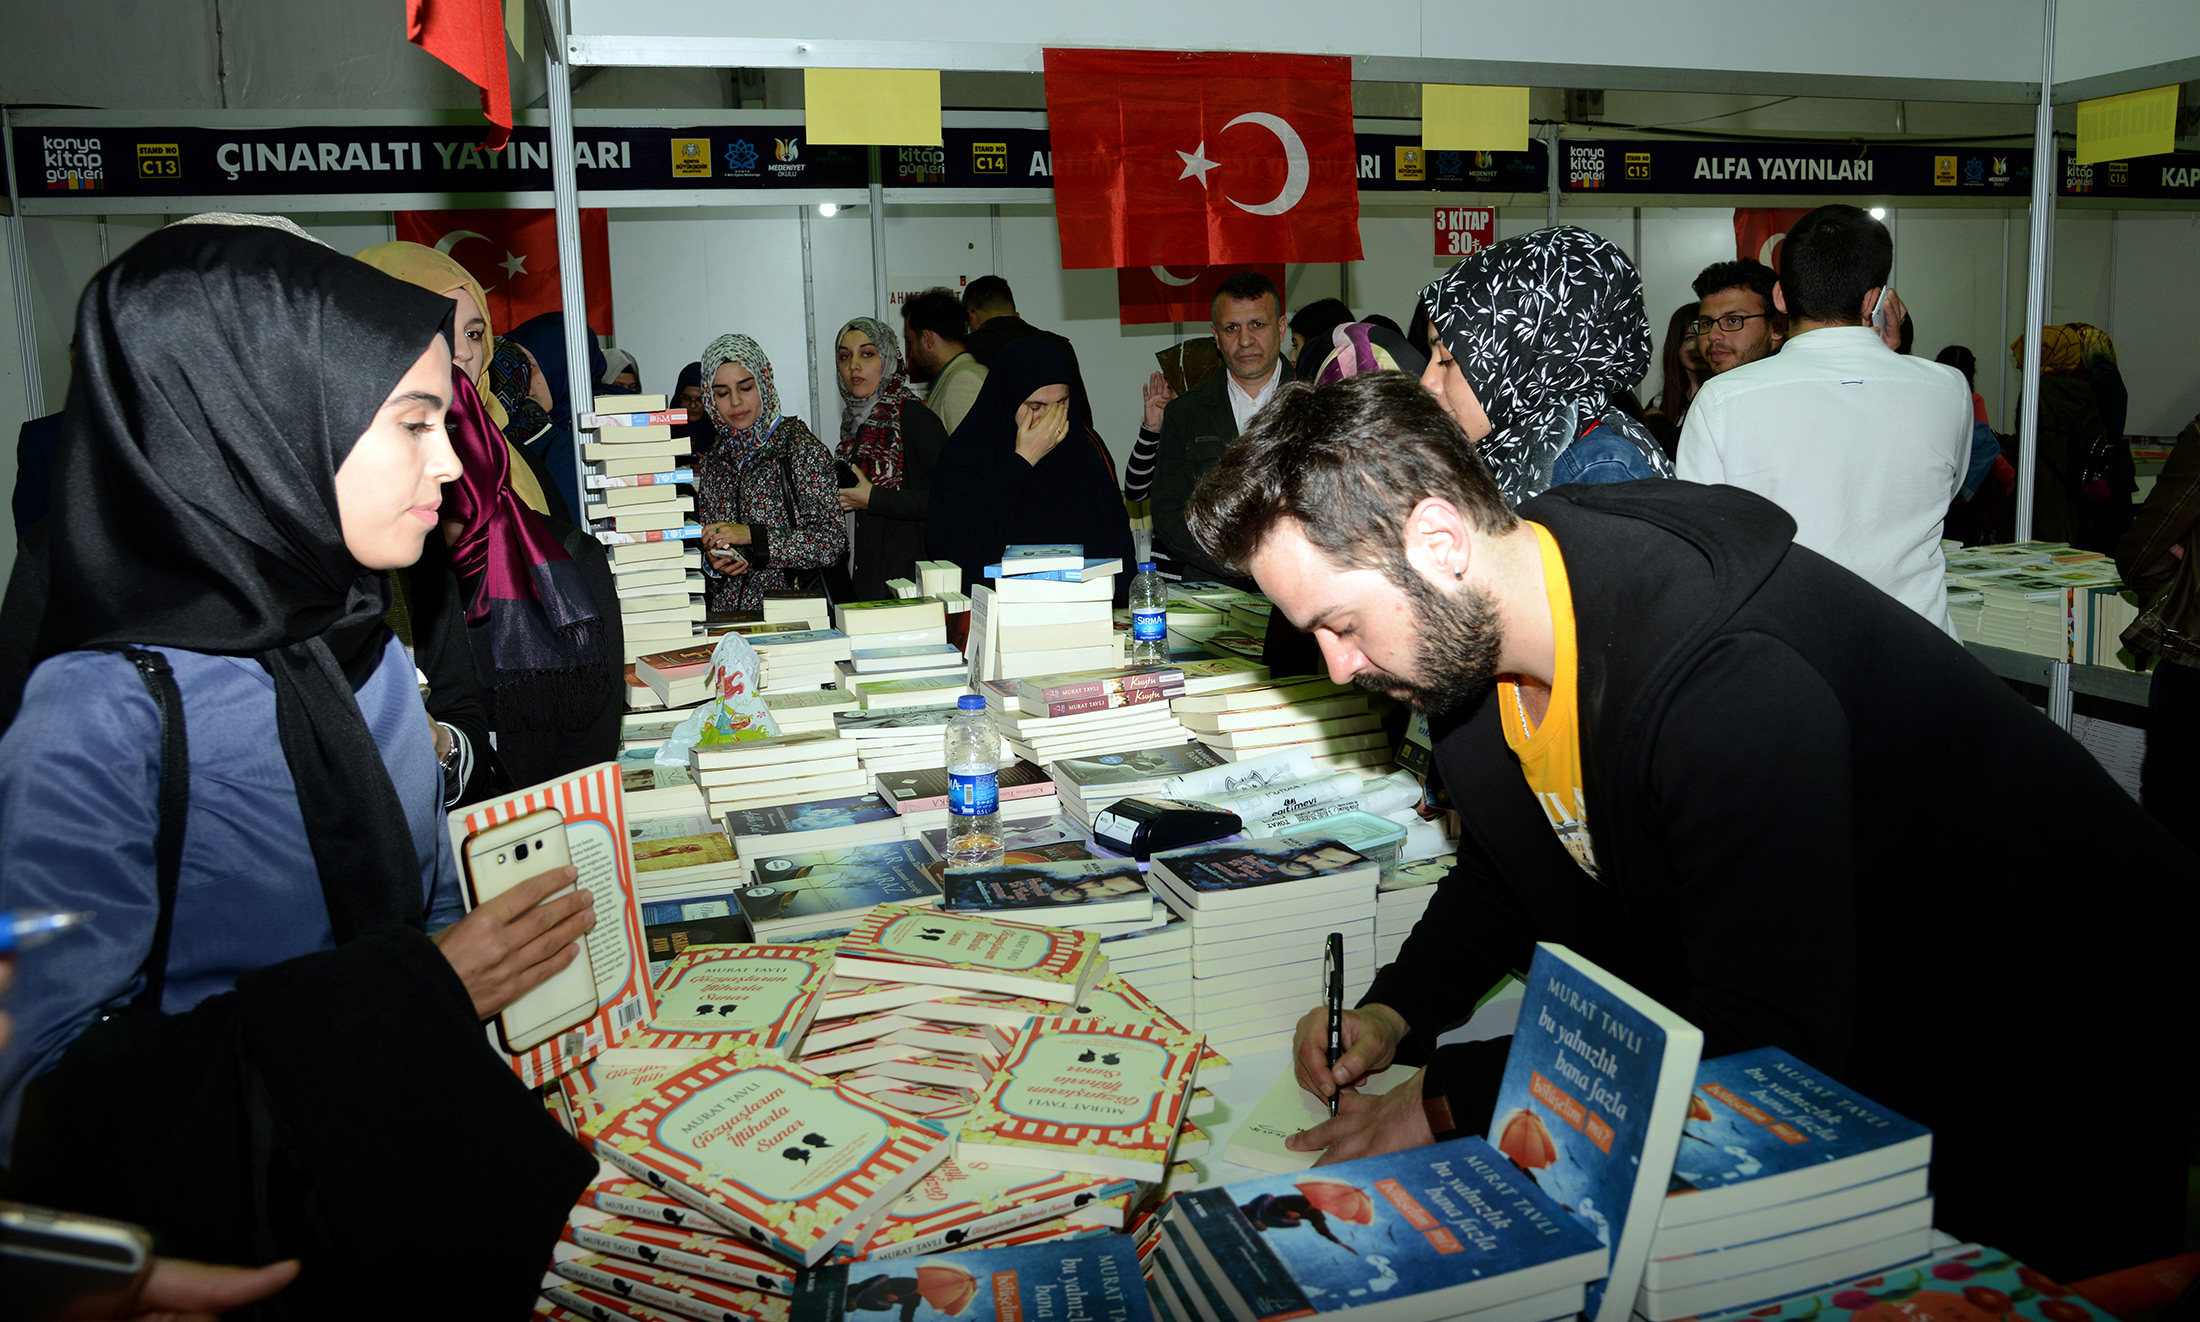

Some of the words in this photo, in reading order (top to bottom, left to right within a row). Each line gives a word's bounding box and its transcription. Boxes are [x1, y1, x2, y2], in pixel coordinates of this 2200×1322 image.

[43, 136, 102, 153] konya
[139, 146, 163, 155] STAND
[165, 147, 177, 155] NO
[1570, 146, 1605, 159] konya
[44, 150, 103, 170] kitap
[216, 142, 423, 181] ÇINARALTI
[432, 141, 632, 171] YAYINARI
[898, 146, 946, 164] kitap
[976, 156, 1005, 171] C14
[142, 159, 177, 175] C13
[898, 162, 946, 177] günleri
[1570, 158, 1605, 173] kitap
[1627, 165, 1649, 178] C15
[1693, 157, 1753, 180] ALFA
[1757, 158, 1874, 182] YAYINLARI
[2066, 166, 2094, 180] kitap
[46, 167, 104, 184] günleri
[1570, 169, 1605, 183] günleri
[2066, 178, 2093, 189] günleri
[2109, 174, 2127, 184] C16
[1436, 210, 1447, 231] 3
[1449, 207, 1490, 231] KİTAP
[655, 473, 677, 484] YOL
[663, 529, 686, 540] YOL
[1137, 615, 1164, 626] SIRMA
[1062, 687, 1083, 697] MURAT
[1083, 685, 1101, 695] TAVLI
[1130, 675, 1157, 690] Kuytu
[1068, 702, 1089, 712] MURAT
[1089, 700, 1106, 710] TAVLI
[1134, 689, 1161, 704] Kuytu
[1267, 819, 1291, 829] TOKAT
[874, 871, 907, 895] ARAZ
[689, 975, 788, 985] Gözyaşlarım
[699, 993, 750, 1001] Sunar
[1547, 976, 1599, 1022] MURAT
[1601, 1011, 1644, 1055] TAVLI
[1538, 1005, 1555, 1034] bu
[1553, 1025, 1619, 1080] yalnızlık
[1066, 1066, 1121, 1079] Sunar
[1053, 1076, 1123, 1092] İftiharla
[1554, 1049, 1590, 1092] bana
[1585, 1077, 1629, 1121] fazla
[1026, 1086, 1140, 1106] Gözyaşlarım
[1028, 1098, 1067, 1109] TAVLI
[1743, 1067, 1769, 1083] bu
[1759, 1082, 1844, 1125] yalnızlık
[1771, 1062, 1838, 1098] MURAT
[1835, 1098, 1891, 1129] TAVLI
[680, 1104, 725, 1134] MURAT
[726, 1082, 761, 1108] TAVLI
[1074, 1102, 1126, 1115] MURAT
[1532, 1077, 1583, 1125] bölüşelim
[1587, 1119, 1611, 1145] mi?
[1748, 1089, 1795, 1117] bana
[1780, 1114, 1840, 1142] fazla
[691, 1087, 787, 1150] Gözyaşlarım
[726, 1106, 792, 1149] İftiharla
[756, 1118, 807, 1154] Sunar
[1430, 1161, 1454, 1178] bu
[1439, 1177, 1514, 1230] yalnızlık
[1463, 1155, 1519, 1196] MURAT
[1512, 1197, 1562, 1235] TAVLI
[605, 1200, 634, 1214] MURAT
[634, 1205, 661, 1219] TAVLI
[1379, 1182, 1430, 1227] bölüşelim
[1431, 1230, 1459, 1250] mi?
[1424, 1186, 1464, 1218] bana
[1446, 1217, 1498, 1252] fazla
[582, 1235, 612, 1250] MURAT
[612, 1242, 638, 1256] TAVLI
[878, 1243, 914, 1262] MURAT
[915, 1237, 942, 1253] TAVLI
[1060, 1258, 1084, 1275] bu
[1098, 1255, 1126, 1306] MURAT
[1035, 1284, 1058, 1319] bana
